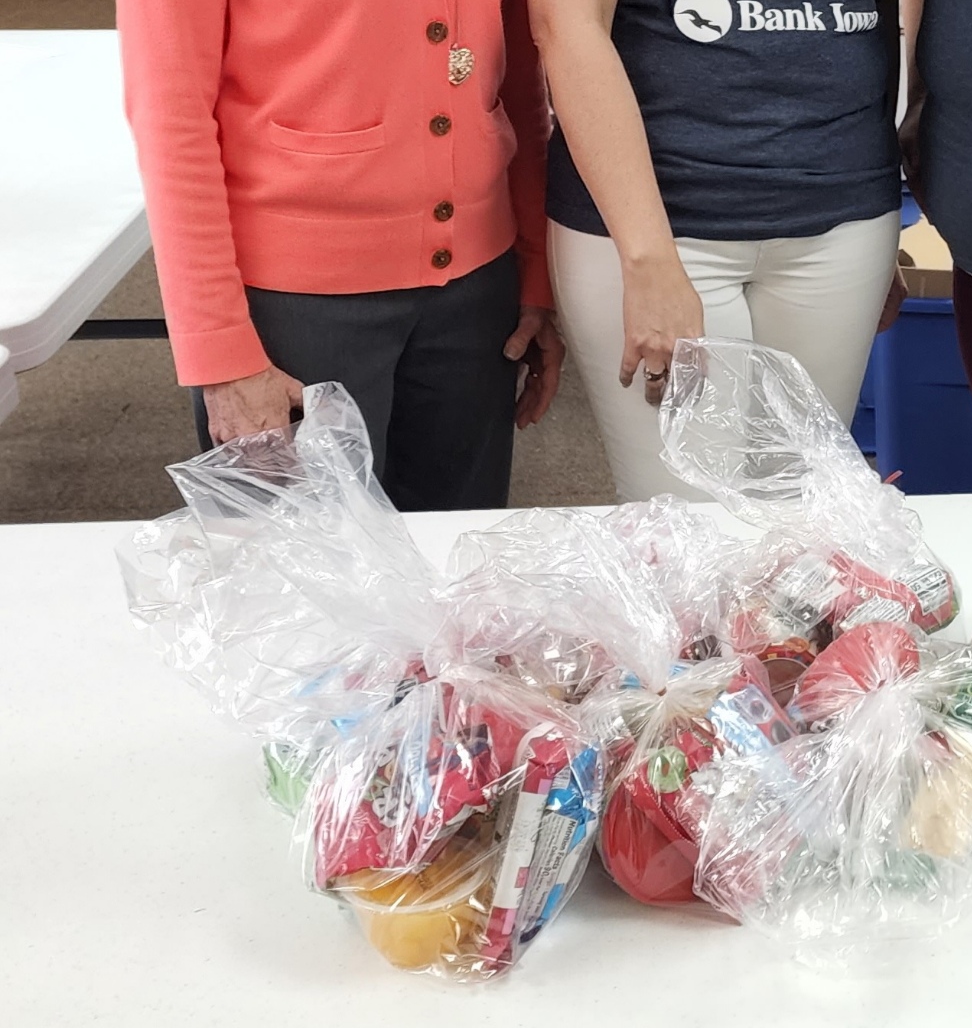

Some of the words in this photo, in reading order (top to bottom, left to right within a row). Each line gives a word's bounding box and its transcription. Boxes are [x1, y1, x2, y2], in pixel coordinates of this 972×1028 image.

[736, 0, 826, 32] Bank
[830, 3, 879, 34] Iowa
[559, 820, 577, 852] Nutrition
[551, 851, 566, 870] Facts
